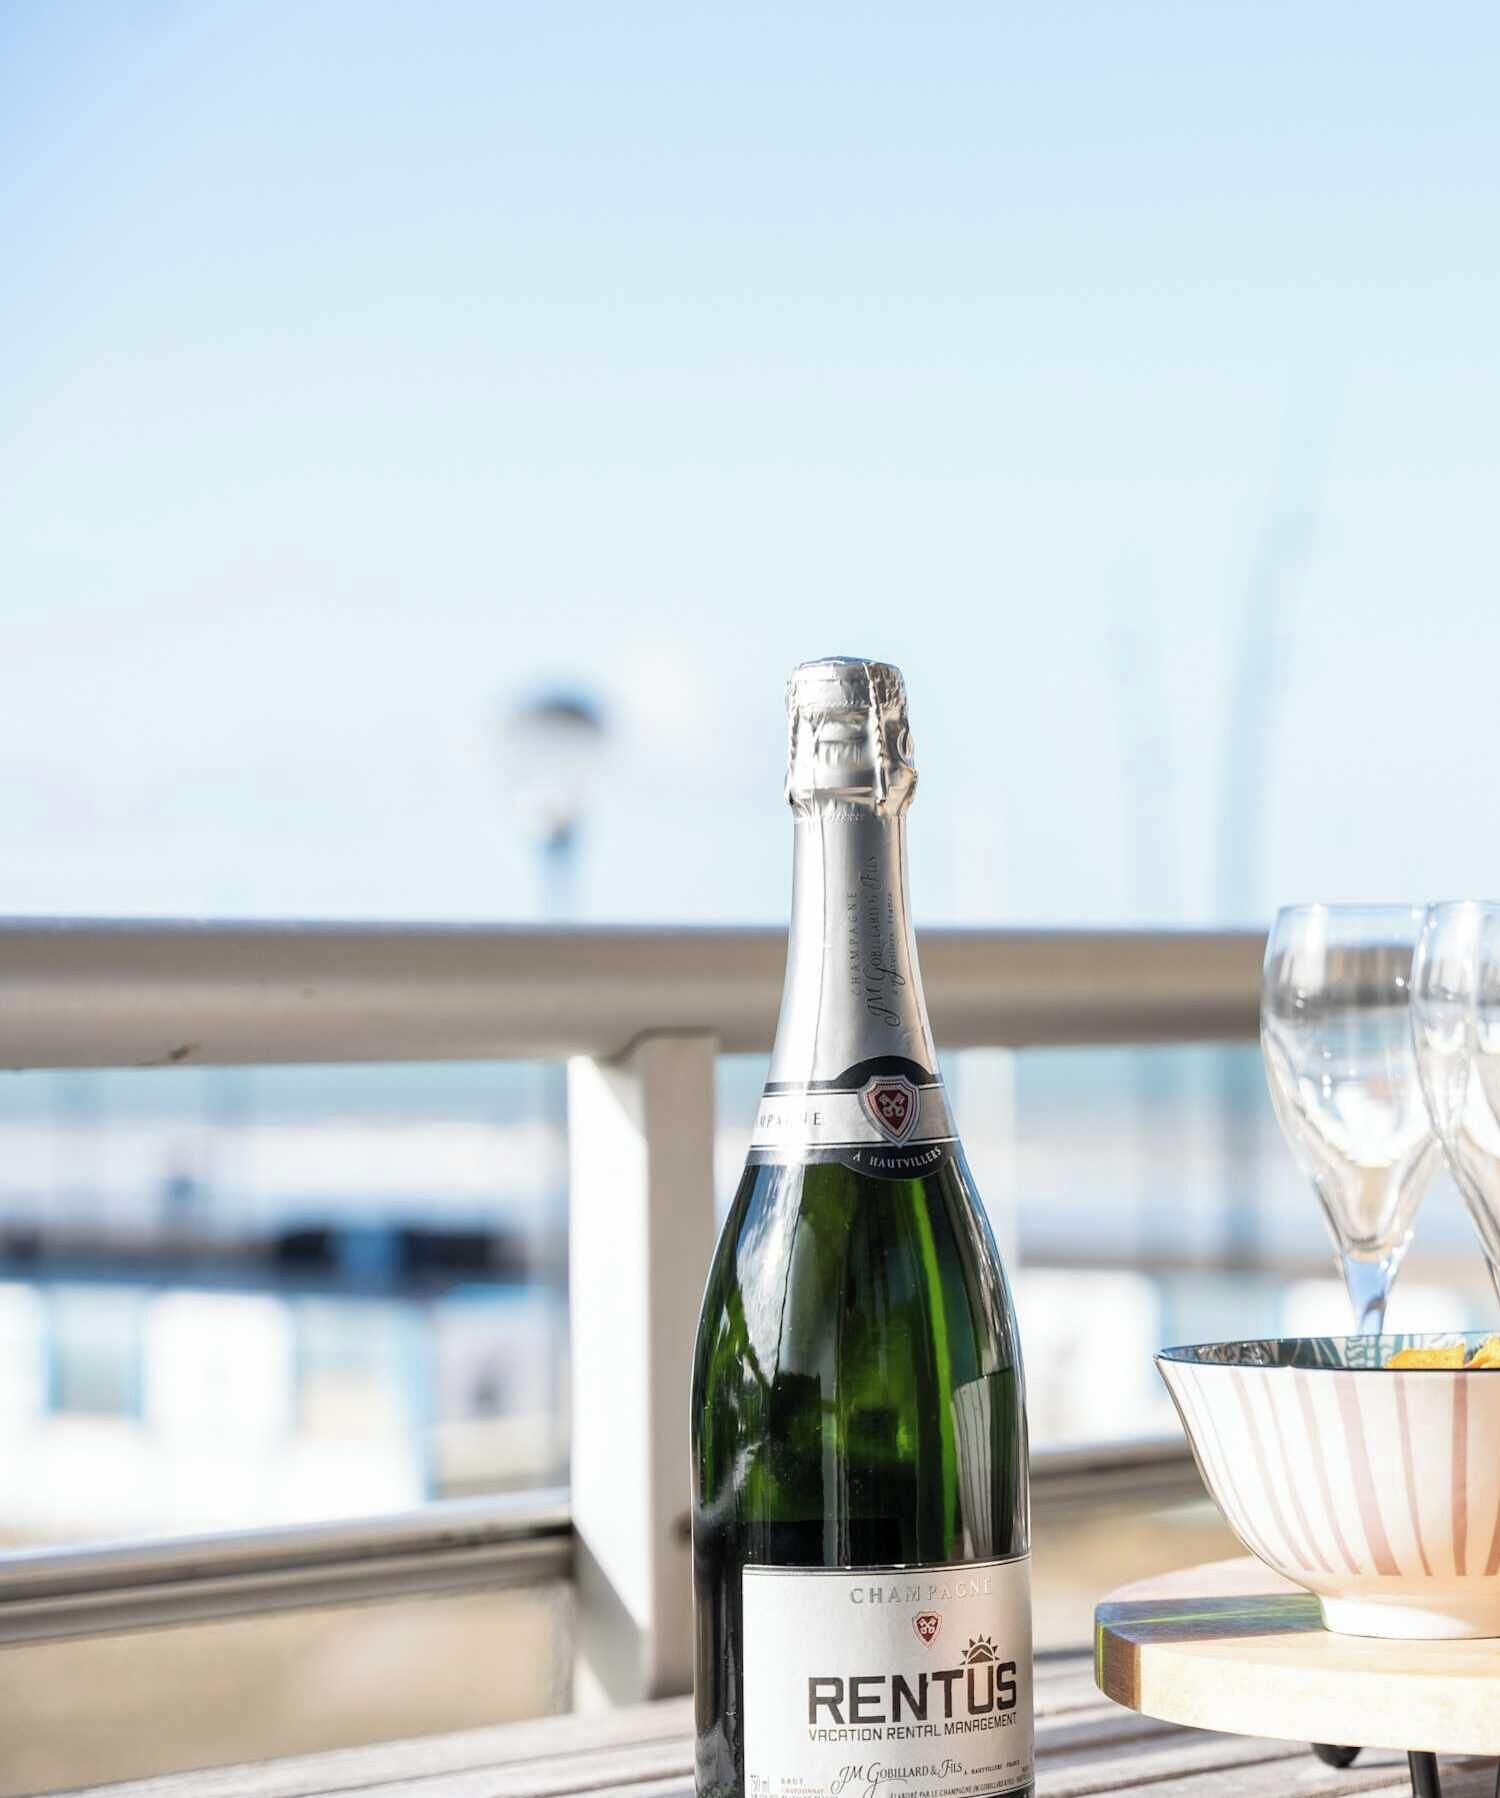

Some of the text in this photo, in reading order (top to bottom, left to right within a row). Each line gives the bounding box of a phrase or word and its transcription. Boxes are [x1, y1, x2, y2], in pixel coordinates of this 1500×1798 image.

[847, 892, 861, 997] CHAMPAGNE
[869, 1145, 942, 1169] HAUTVILLERS
[850, 1575, 993, 1605] CHAMPAGNE
[808, 1660, 1017, 1725] RENTUS
[808, 1712, 1017, 1743] VACATION RENTAL MANAGEMENT
[862, 1761, 929, 1798] GOBILLARD
